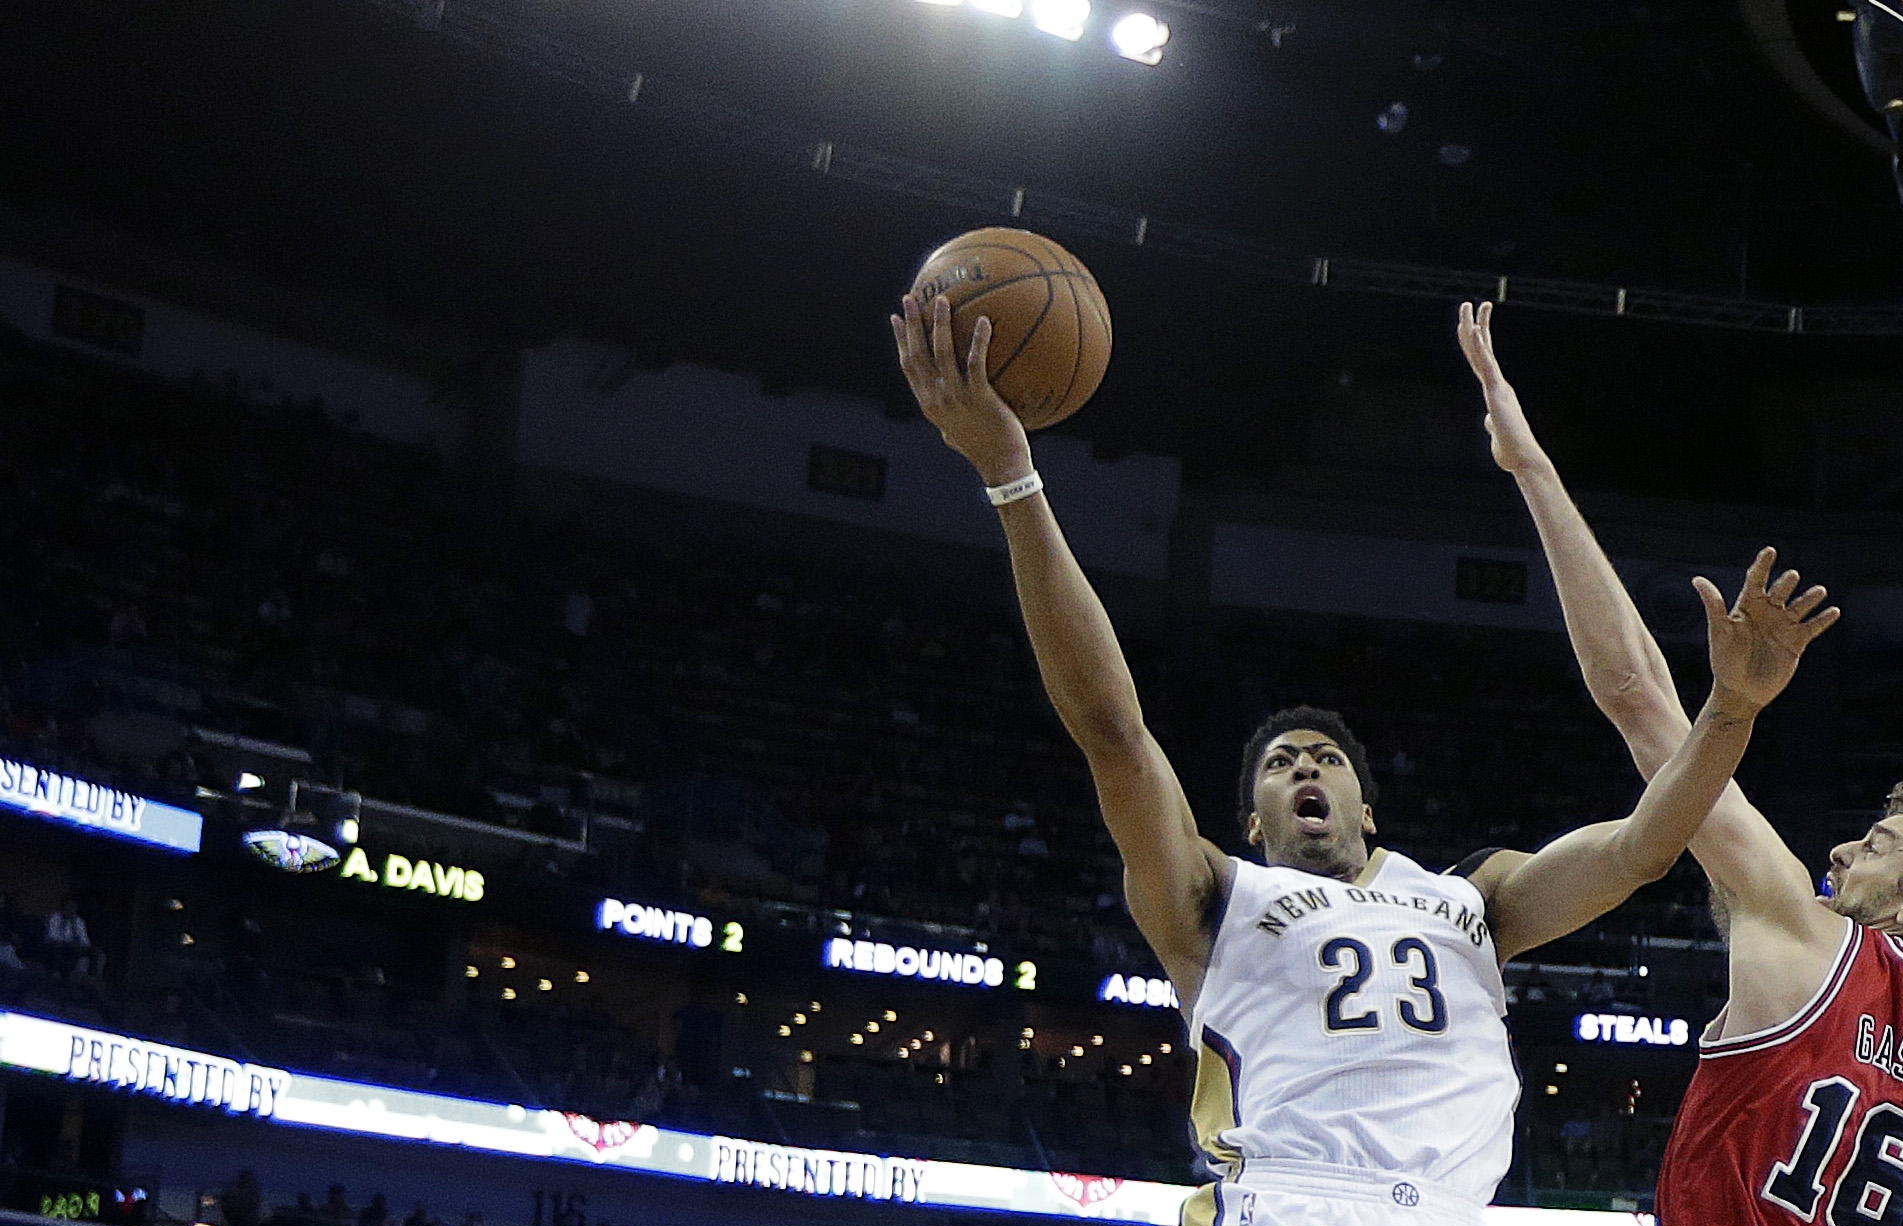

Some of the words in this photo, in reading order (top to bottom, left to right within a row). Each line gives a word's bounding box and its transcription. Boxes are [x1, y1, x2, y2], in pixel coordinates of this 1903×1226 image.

[109, 787, 147, 826] BY
[342, 847, 378, 882] A.
[384, 853, 485, 902] DAVIS
[601, 897, 713, 948] POINTS
[721, 921, 744, 952] 2
[1257, 886, 1332, 937] NEW
[1345, 887, 1489, 948] ORLEANS
[829, 937, 1004, 986] REBOUNDS
[1017, 960, 1037, 990] 2
[1318, 935, 1450, 1036] 23
[1578, 1013, 1689, 1046] STEALS
[69, 1034, 237, 1107] PRESENTED
[249, 1072, 283, 1119] BY
[718, 1142, 877, 1198] PRESENTED
[892, 1165, 926, 1203] BY
